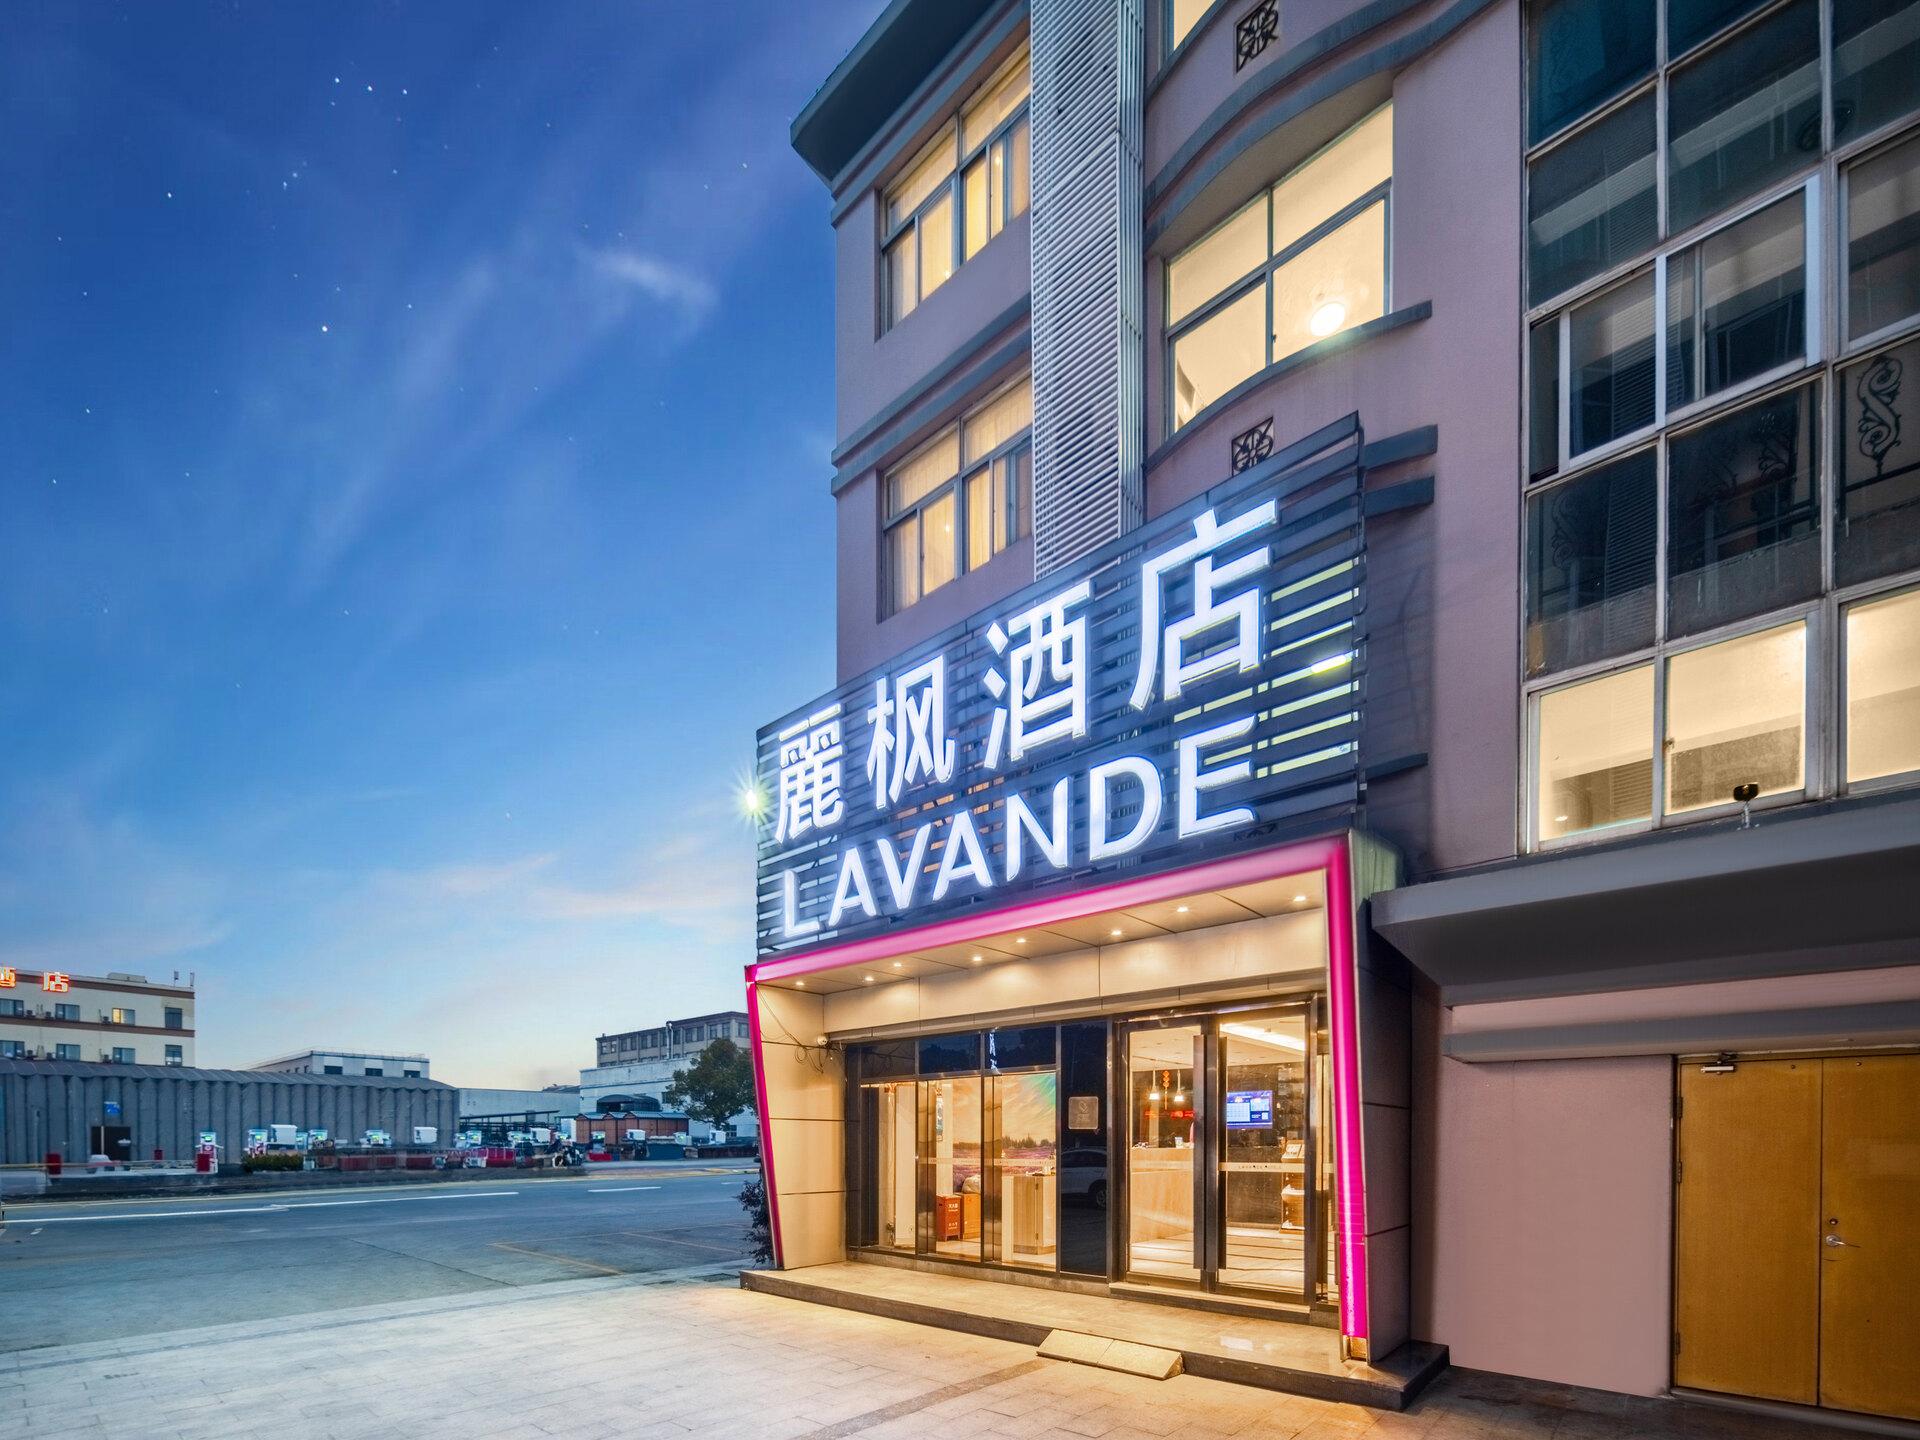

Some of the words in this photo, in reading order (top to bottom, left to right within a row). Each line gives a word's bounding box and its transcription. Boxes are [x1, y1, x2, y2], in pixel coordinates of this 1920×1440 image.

[774, 498, 1277, 844] 麗枫酒店
[783, 714, 1259, 937] LAVANDE
